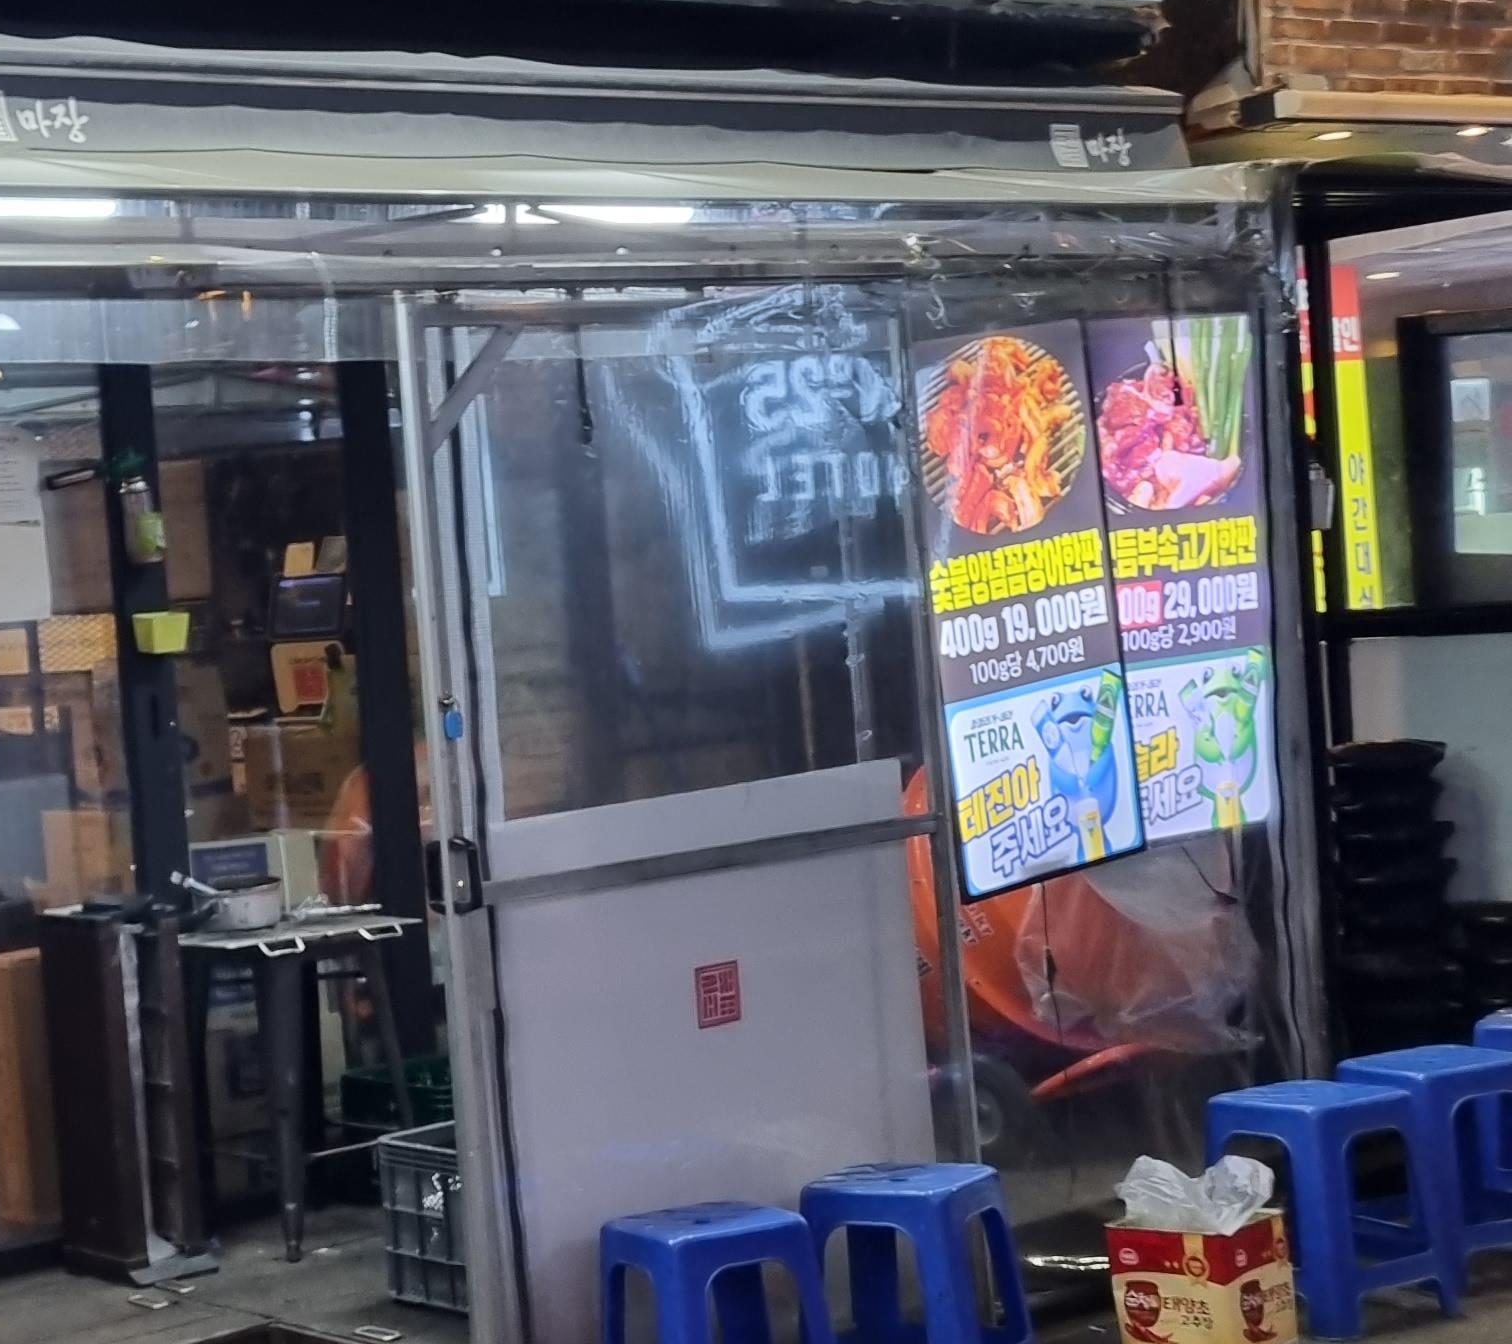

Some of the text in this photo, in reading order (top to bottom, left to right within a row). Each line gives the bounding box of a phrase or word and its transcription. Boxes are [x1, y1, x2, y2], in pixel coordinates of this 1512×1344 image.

[16, 96, 90, 143] 마장
[1085, 127, 1133, 166] 마장
[940, 613, 1000, 659] 400g
[1121, 623, 1175, 652] 100g당
[970, 635, 1086, 684] 100g당 4,700원
[963, 721, 1025, 764] TERRA
[958, 754, 1041, 843] 테진아
[990, 794, 1073, 878] 주세요
